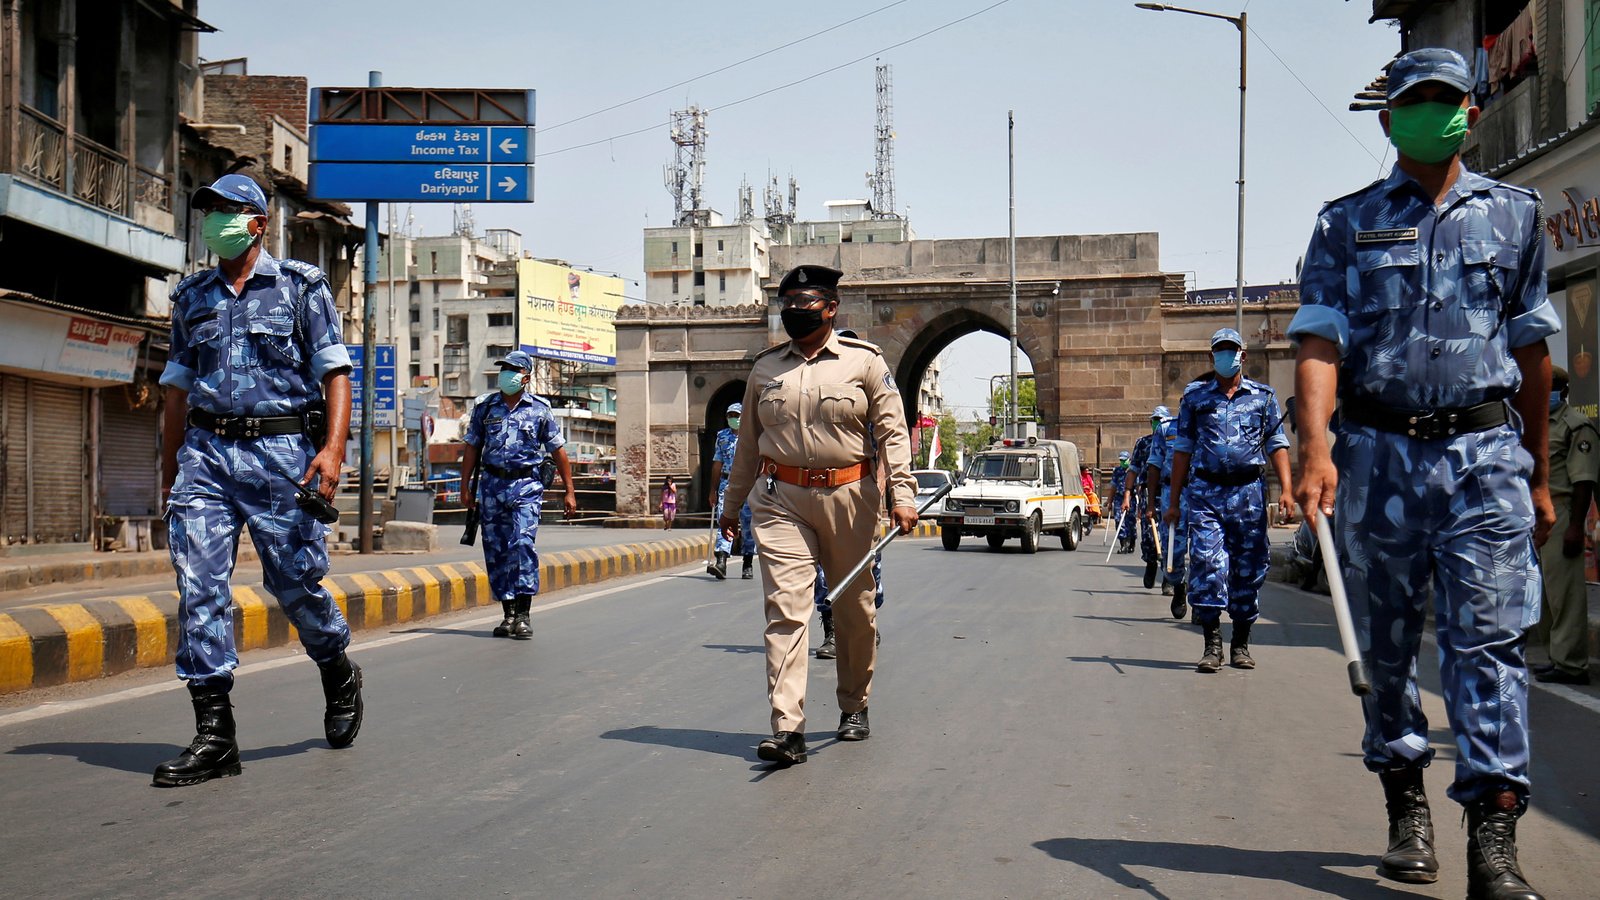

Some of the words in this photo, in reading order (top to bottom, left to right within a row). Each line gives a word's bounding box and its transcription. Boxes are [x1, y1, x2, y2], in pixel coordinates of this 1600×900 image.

[411, 145, 455, 155] Income
[457, 145, 479, 155] Tax
[434, 167, 479, 184] દરિયાપુર
[421, 183, 479, 196] Dariyapur
[526, 289, 555, 312] नेशनल
[71, 321, 109, 342] ચામુંડા
